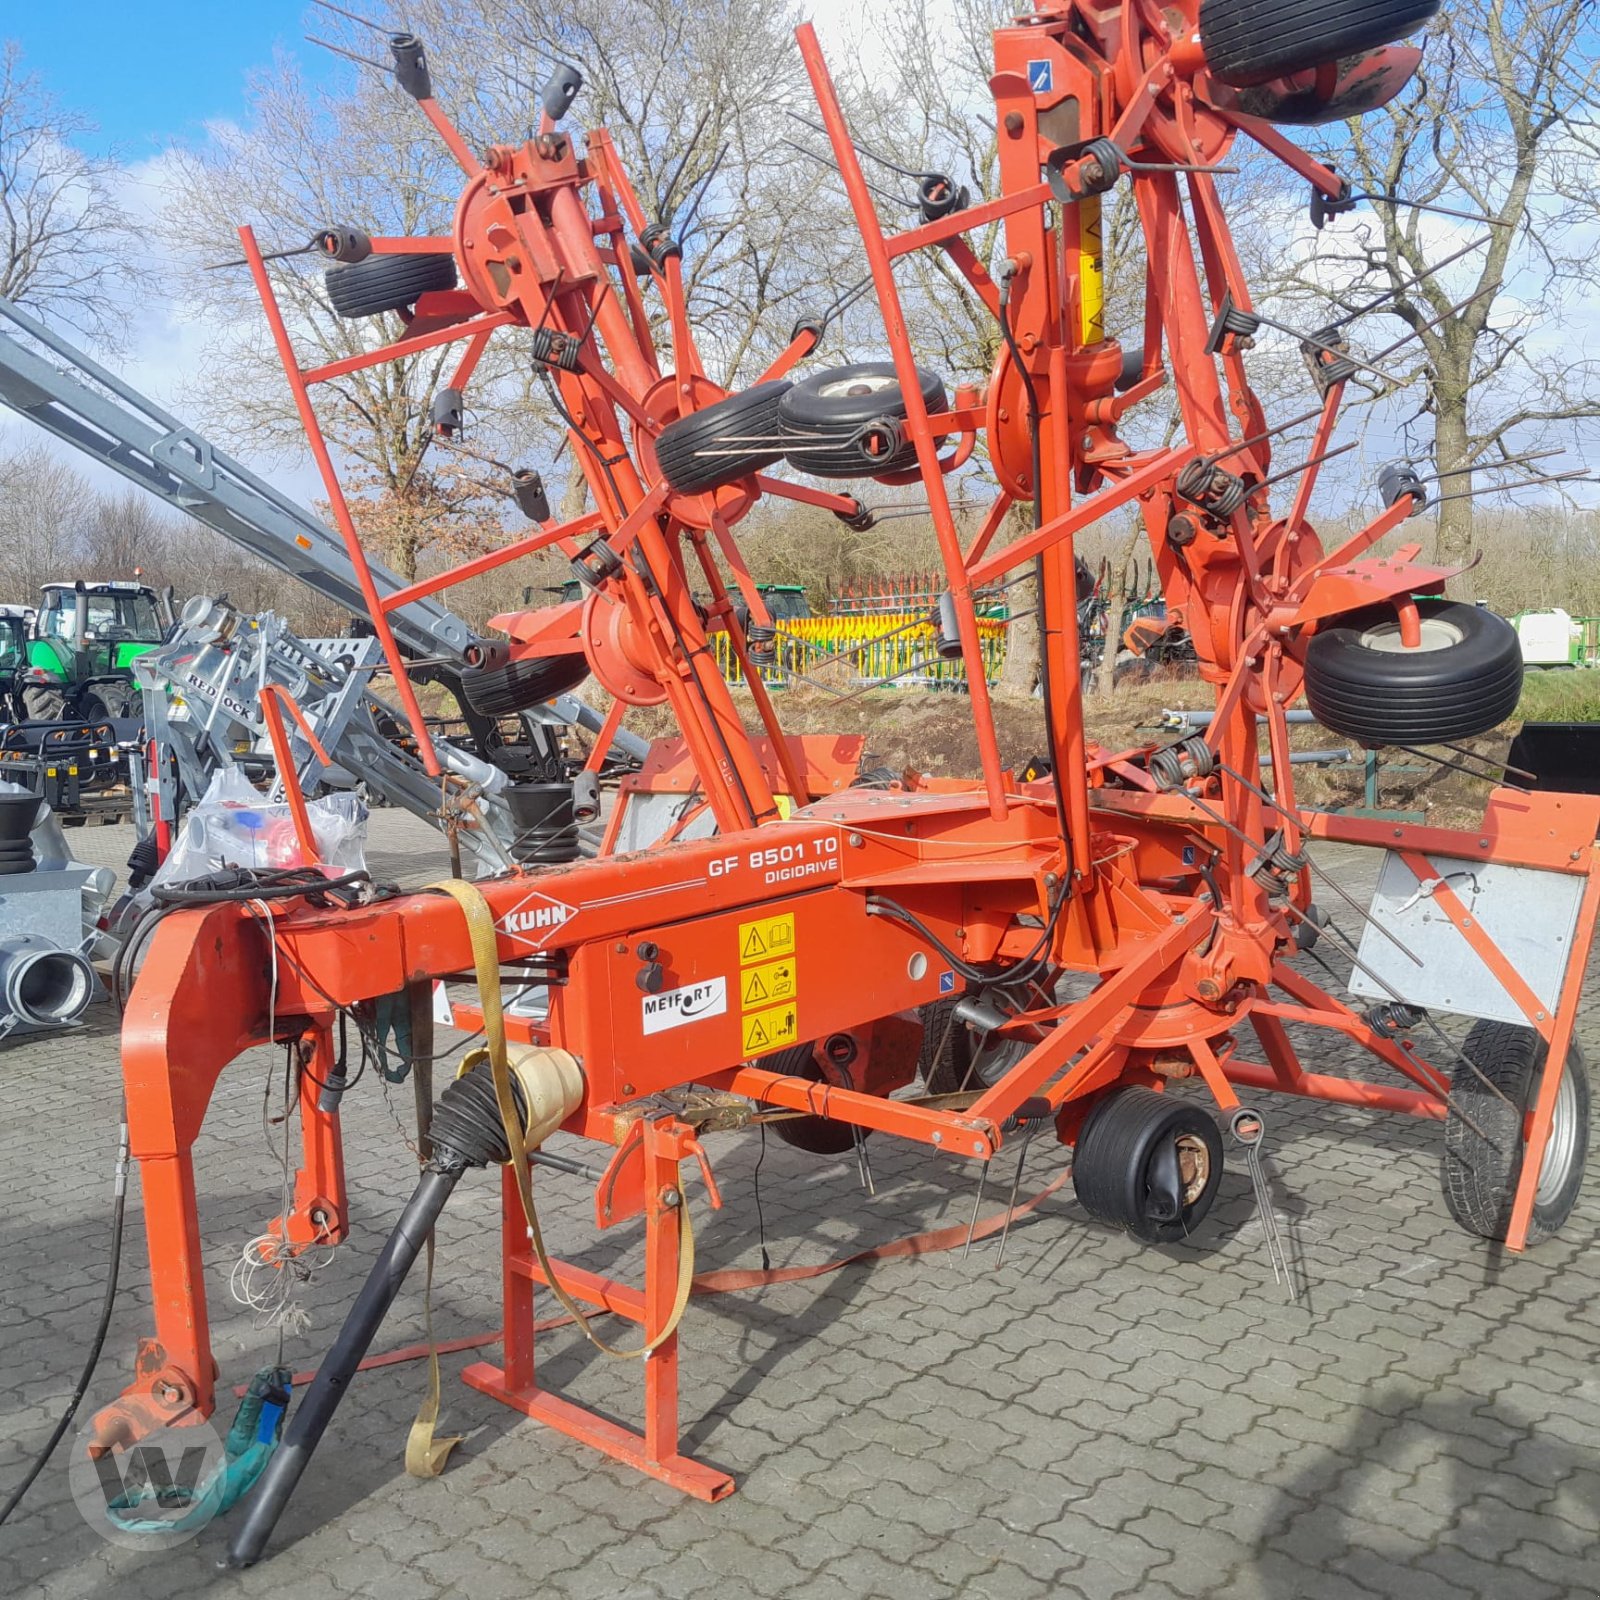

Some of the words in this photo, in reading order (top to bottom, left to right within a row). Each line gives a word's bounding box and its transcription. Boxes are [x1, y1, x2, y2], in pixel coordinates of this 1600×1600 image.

[188, 674, 251, 720] REDOCK
[708, 856, 739, 877] GF
[749, 843, 804, 869] 8501
[812, 836, 838, 855] TO
[765, 858, 838, 884] DIGIDRIVE
[504, 904, 567, 934] KUHN
[644, 985, 713, 1016] MEIFORT
